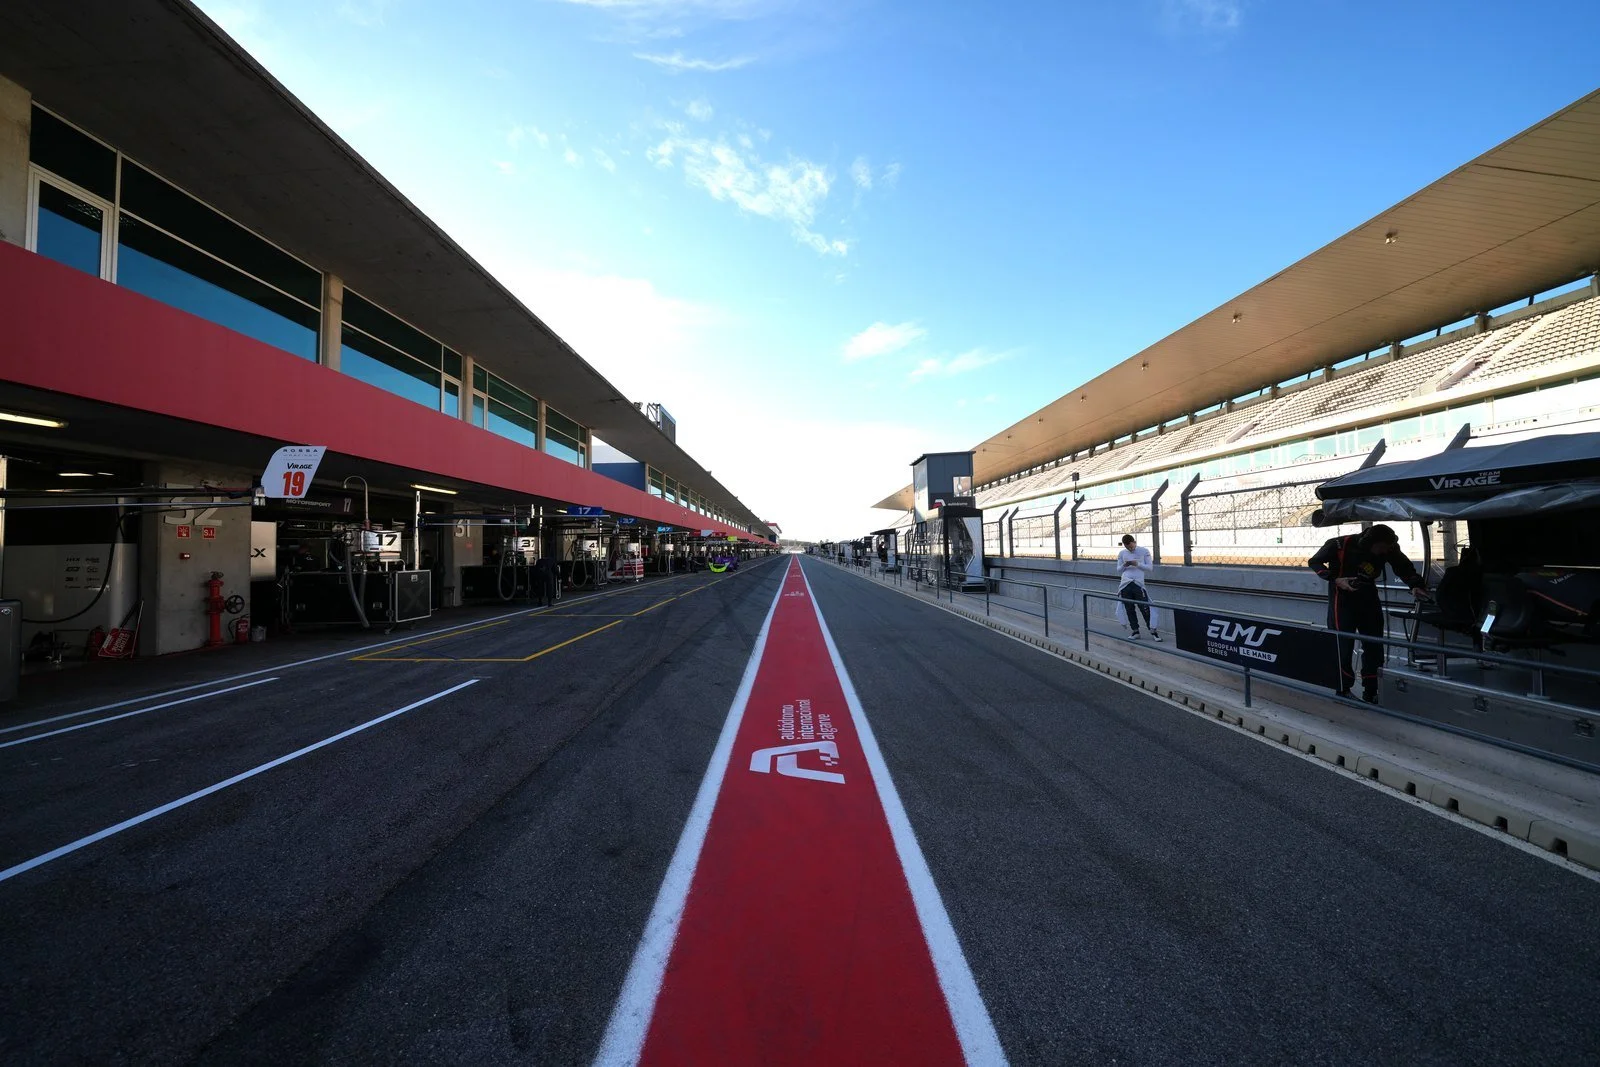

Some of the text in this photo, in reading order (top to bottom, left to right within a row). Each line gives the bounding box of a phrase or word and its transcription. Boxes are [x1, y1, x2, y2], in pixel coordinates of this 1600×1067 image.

[282, 471, 305, 496] 19
[1428, 474, 1502, 490] VIRAGE
[286, 498, 332, 507] MOTORSPORT
[578, 506, 592, 514] 17
[375, 534, 398, 546] 17
[1206, 618, 1282, 647] ELMS
[1207, 640, 1238, 653] EUROPEAN
[1252, 650, 1272, 660] MANS
[1208, 647, 1228, 656] SERIES
[777, 704, 794, 740] autódromo
[796, 698, 814, 740] internacional
[816, 714, 838, 740] algarve
